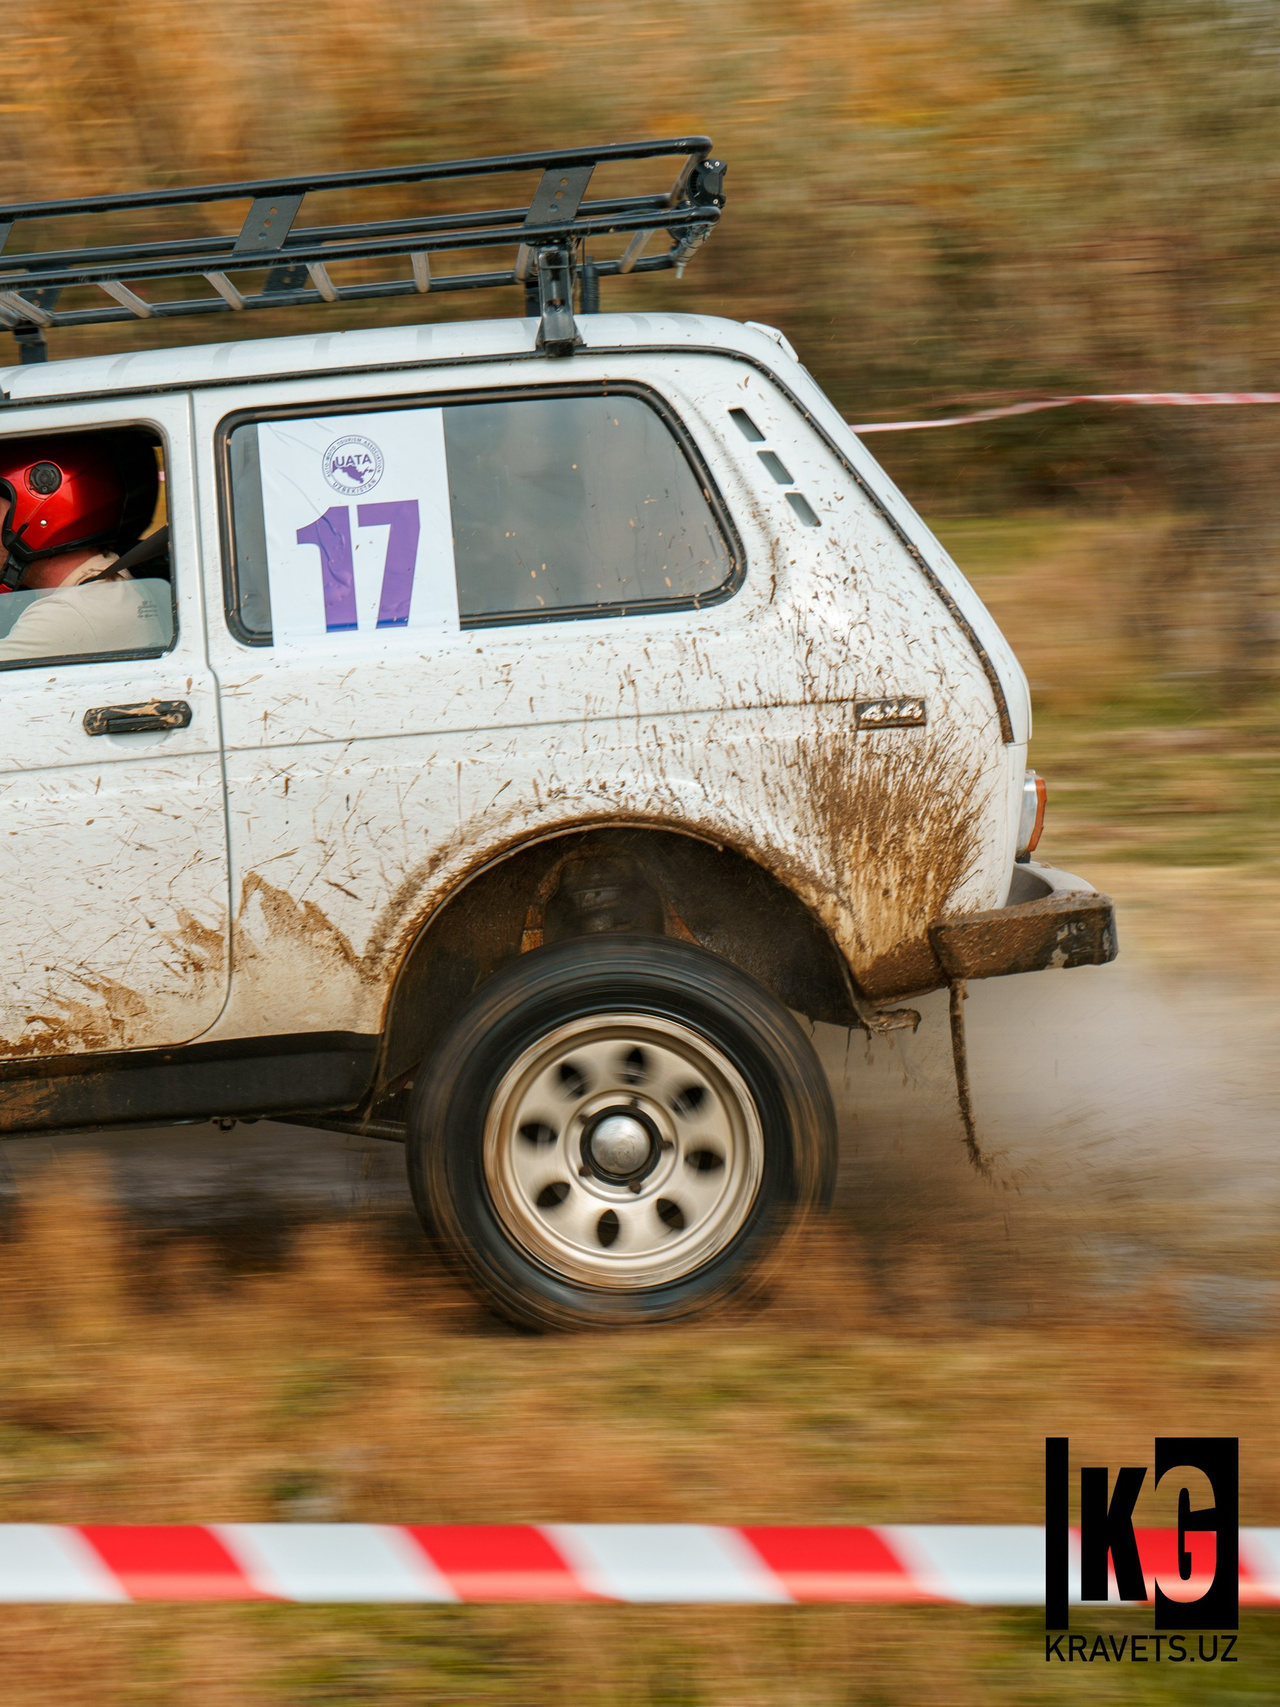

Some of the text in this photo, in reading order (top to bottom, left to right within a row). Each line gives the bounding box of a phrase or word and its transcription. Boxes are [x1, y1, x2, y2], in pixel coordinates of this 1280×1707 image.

[335, 453, 372, 467] UATA
[332, 479, 377, 493] UZBEKISTAN
[296, 499, 420, 633] 17
